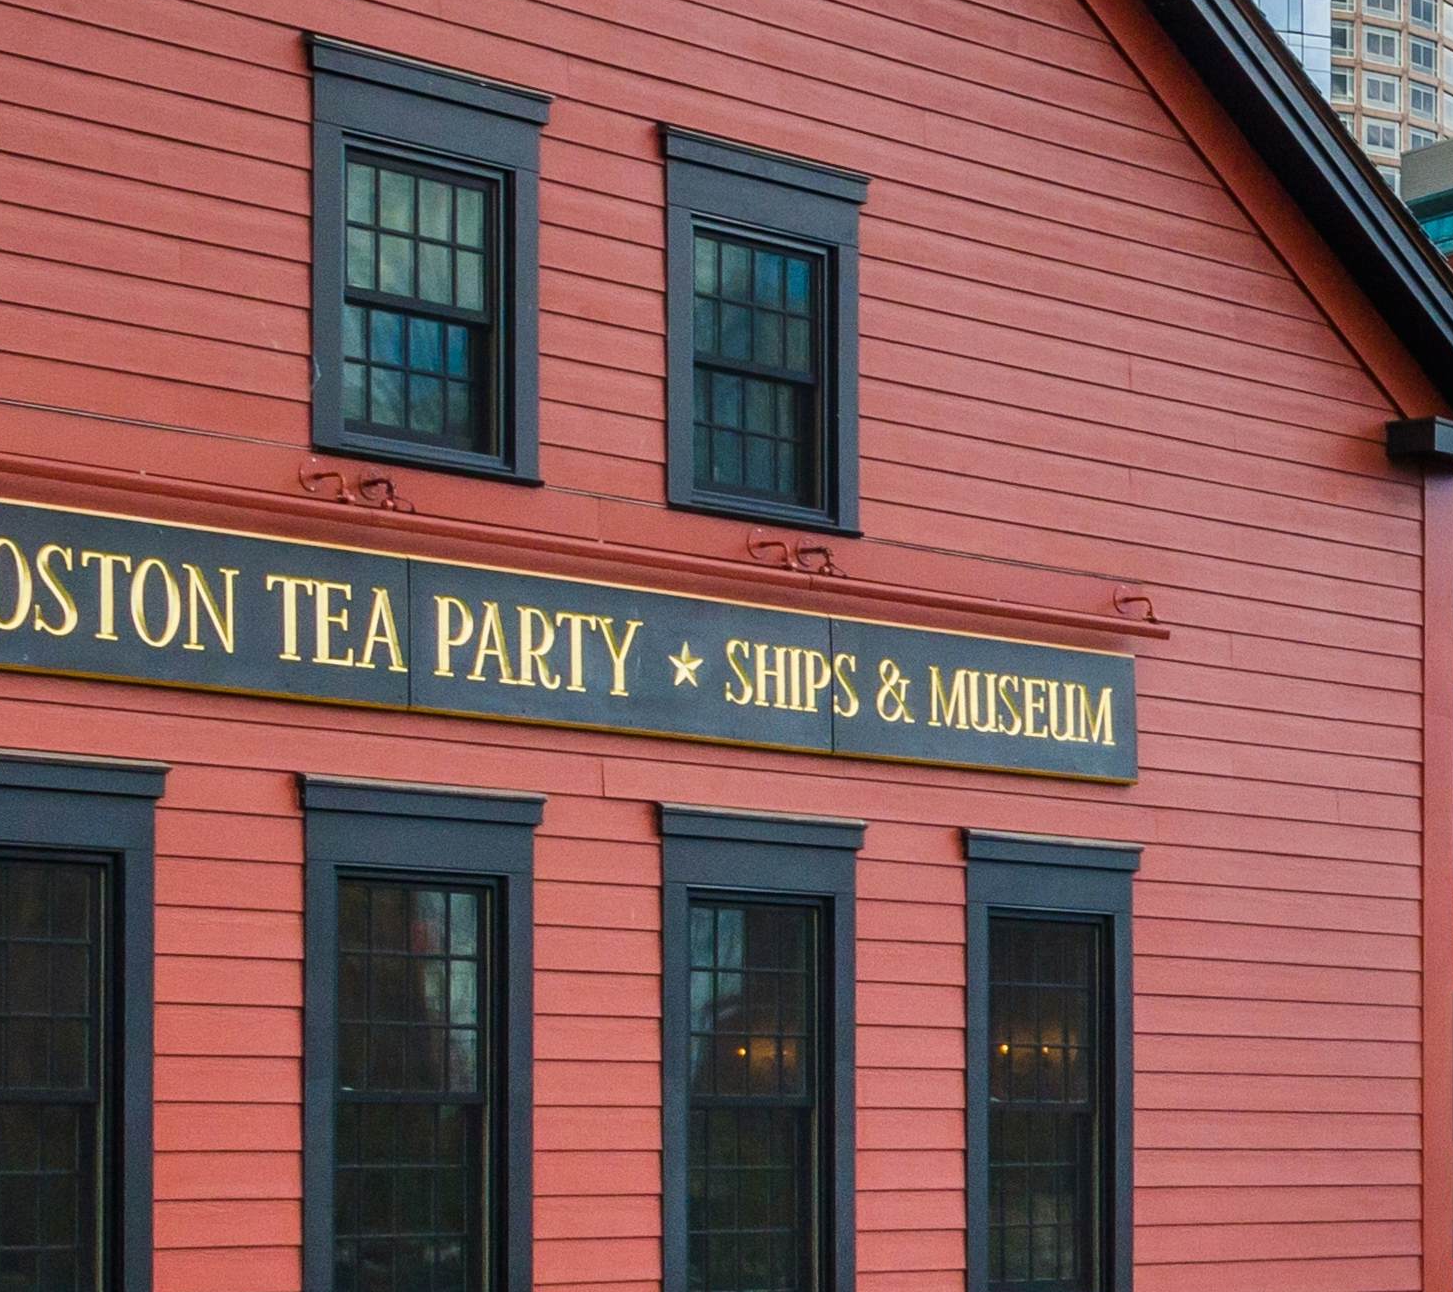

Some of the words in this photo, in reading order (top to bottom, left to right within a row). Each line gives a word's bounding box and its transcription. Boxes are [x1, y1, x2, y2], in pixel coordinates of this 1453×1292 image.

[266, 574, 408, 673] TEA
[433, 594, 644, 697] PARTY
[724, 638, 860, 718] SHIPS
[876, 658, 915, 724] &
[928, 665, 1116, 746] MUSEUM
